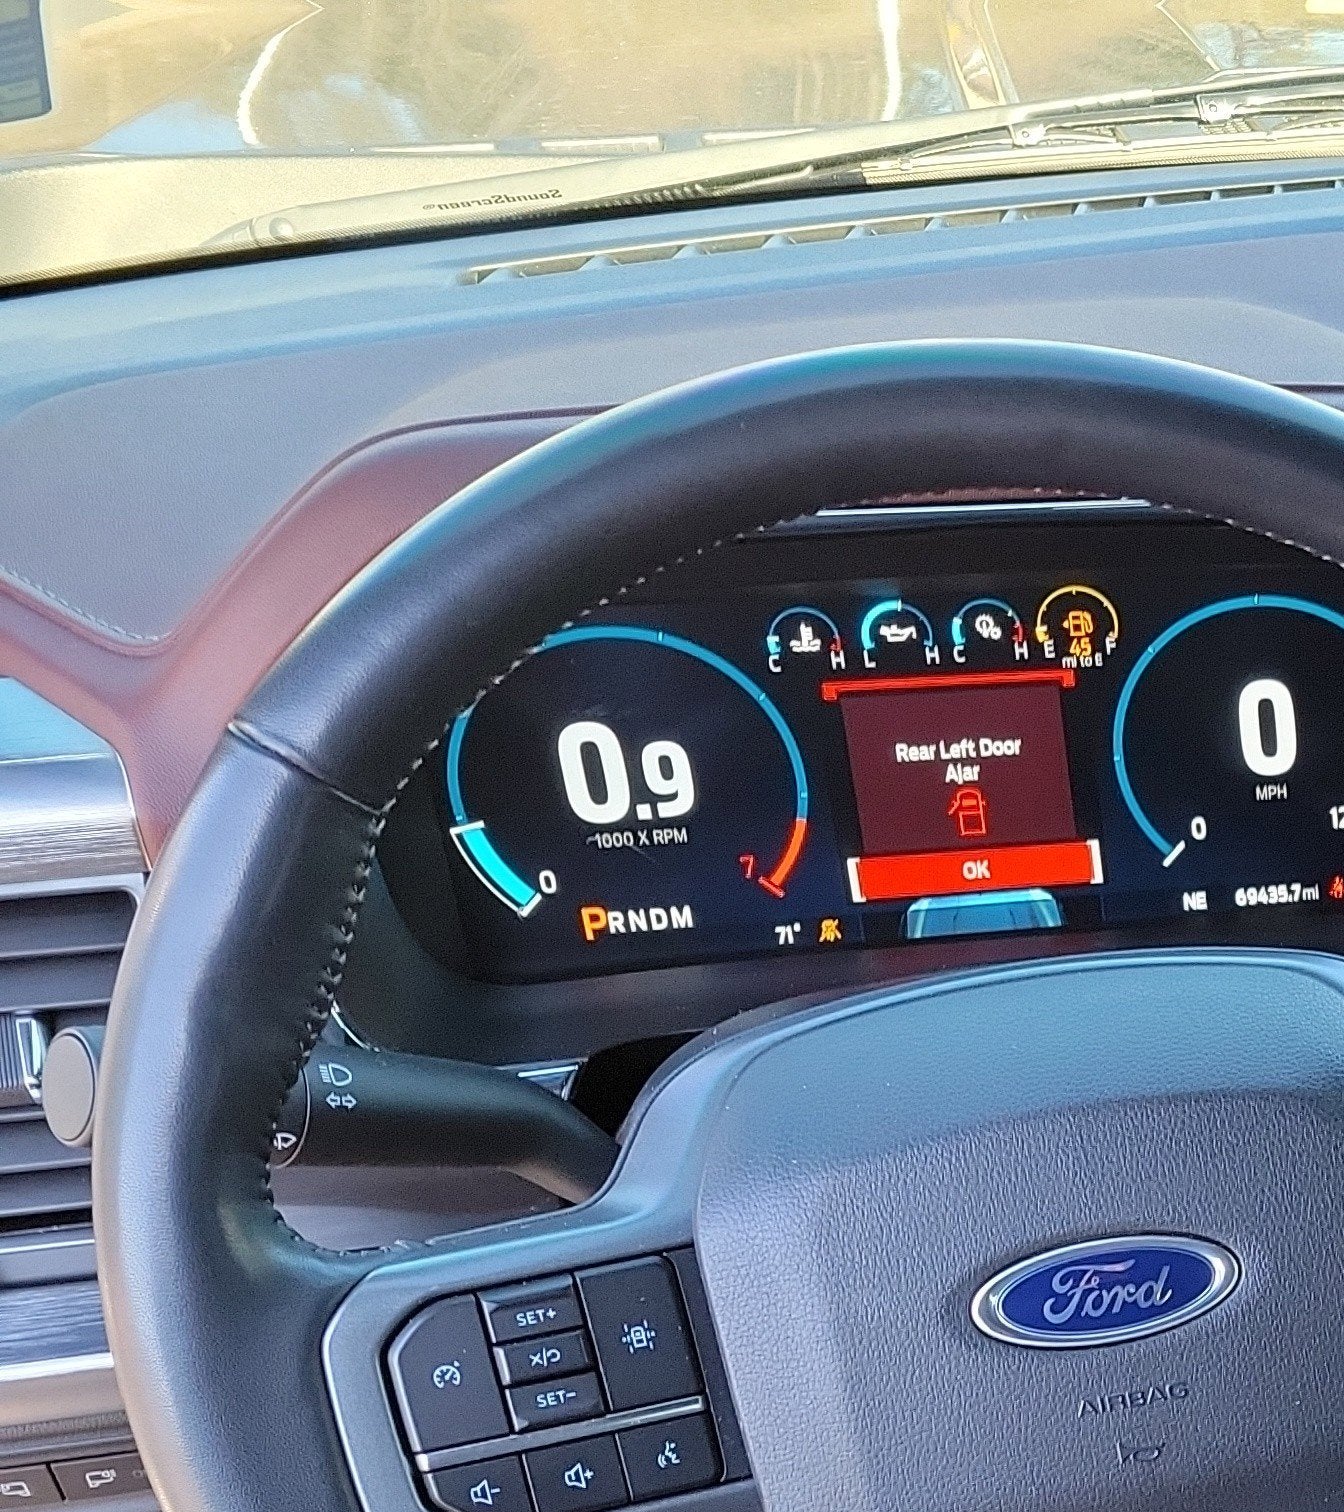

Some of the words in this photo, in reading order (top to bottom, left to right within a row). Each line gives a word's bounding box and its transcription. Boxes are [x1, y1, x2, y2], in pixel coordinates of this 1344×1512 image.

[1069, 636, 1092, 657] 45
[1237, 678, 1298, 777] 0
[895, 742, 936, 762] Rear
[939, 739, 975, 760] Left
[978, 737, 1021, 757] Door
[557, 721, 695, 825] 0.9
[945, 762, 981, 784] Ajar
[1255, 783, 1289, 802] MPH
[652, 827, 688, 845] RPM
[1190, 818, 1207, 840] 0
[739, 854, 754, 879] 7
[962, 860, 991, 881] OK
[538, 869, 557, 894] 0
[1183, 890, 1208, 911] NE
[1043, 1259, 1172, 1324] Ford
[1078, 1381, 1190, 1418] AIRBAG
